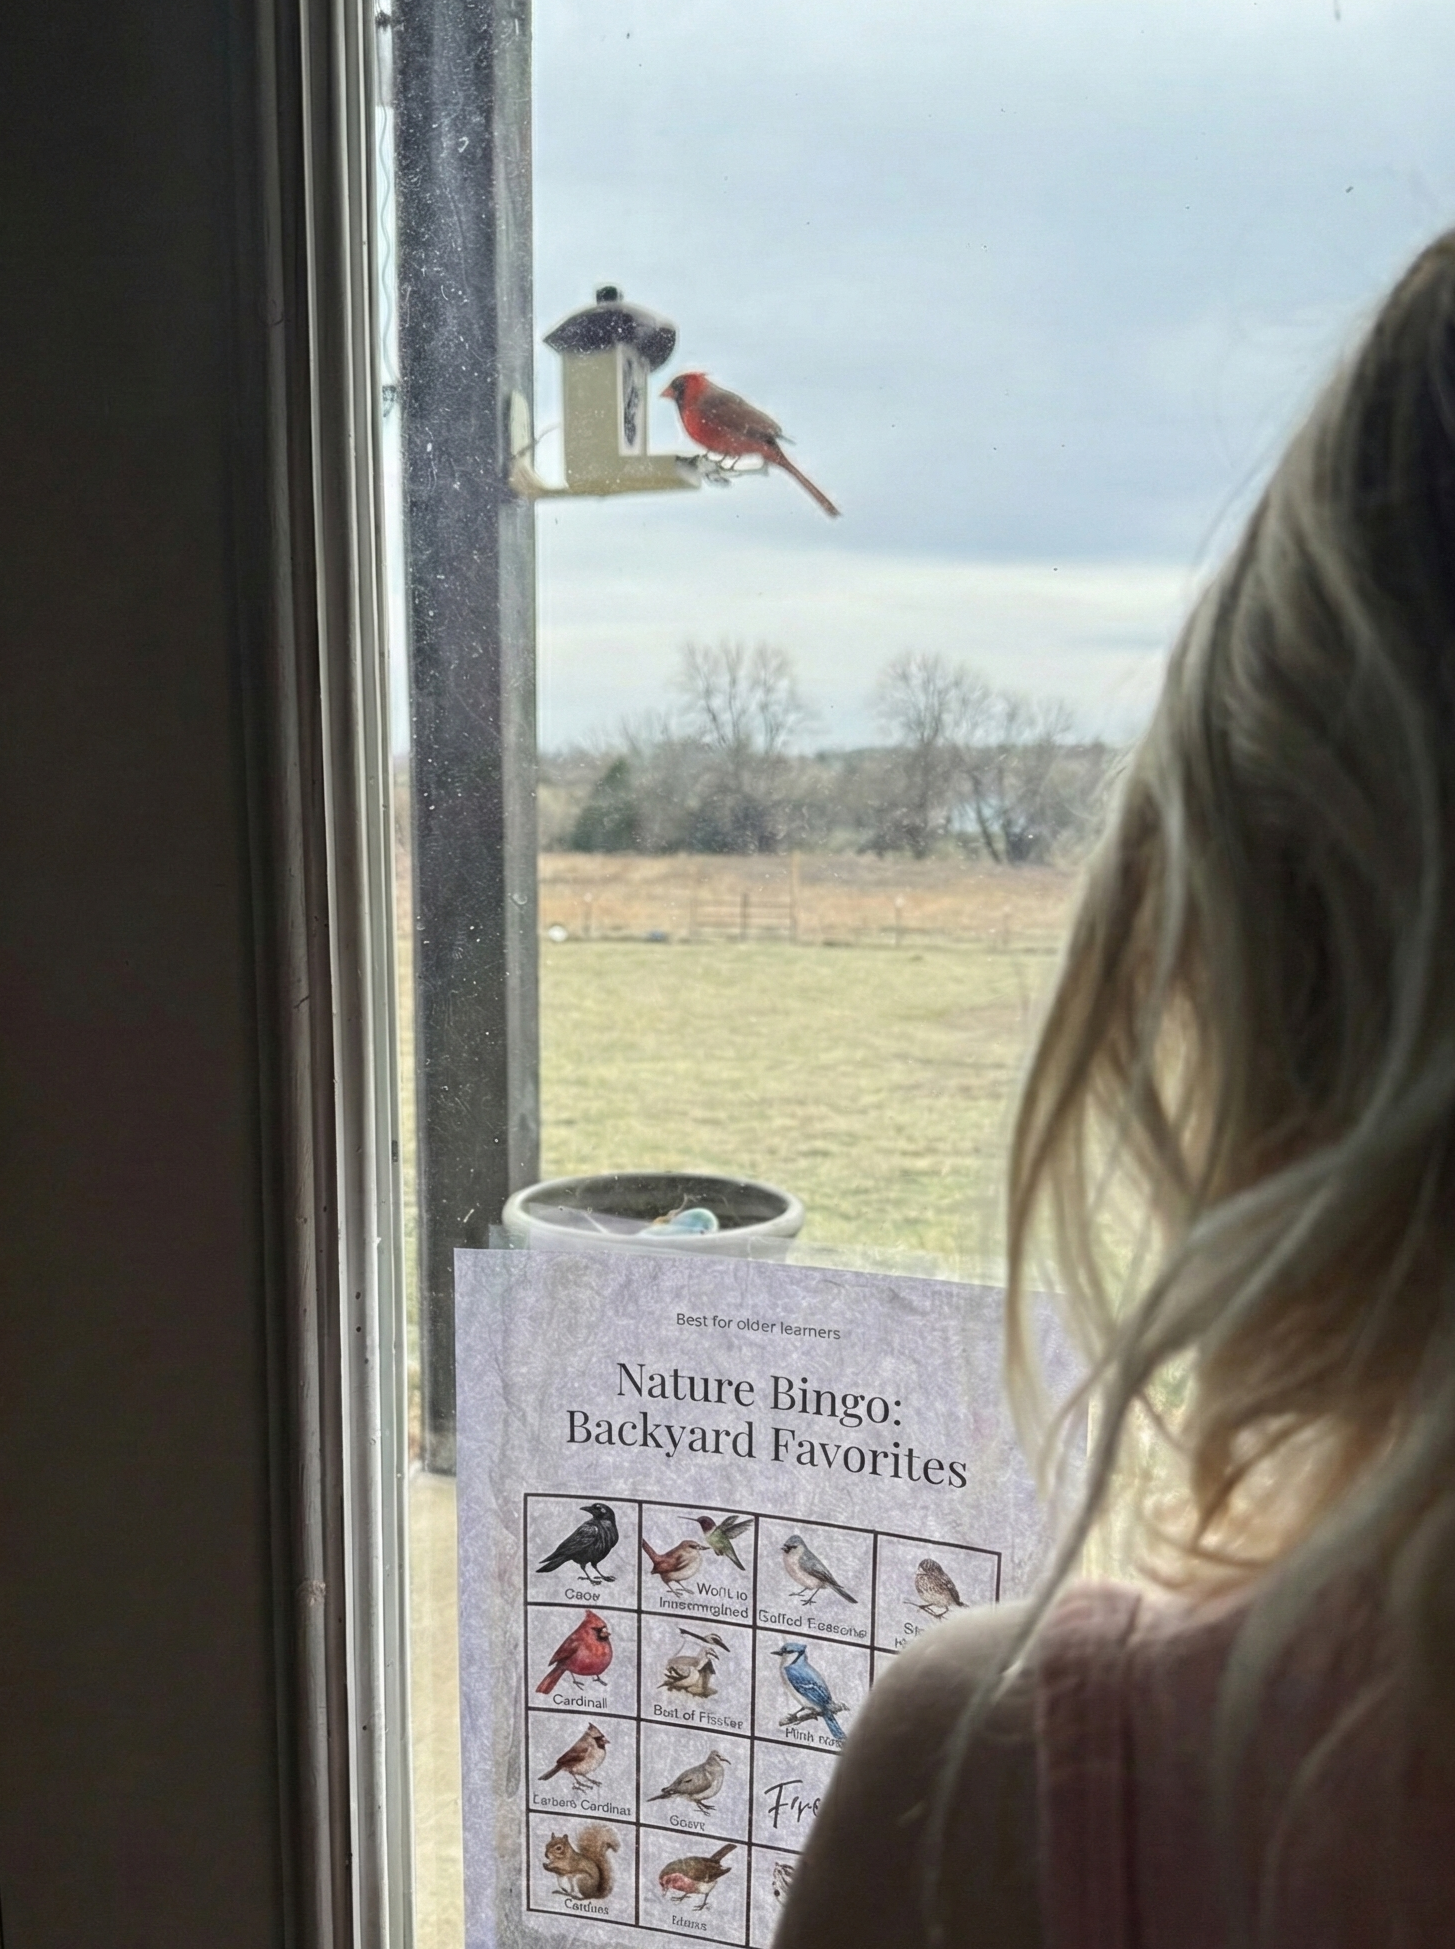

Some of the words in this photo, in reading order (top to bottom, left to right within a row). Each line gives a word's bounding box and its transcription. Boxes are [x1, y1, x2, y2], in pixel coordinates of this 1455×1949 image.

[676, 1312, 708, 1328] Best
[712, 1314, 733, 1330] for
[736, 1317, 776, 1334] older
[780, 1321, 842, 1341] learners
[616, 1362, 756, 1407] Nature
[770, 1375, 902, 1428] Bingo:
[566, 1409, 757, 1459] Backyard
[770, 1426, 968, 1489] Favorites
[683, 1710, 695, 1721] of
